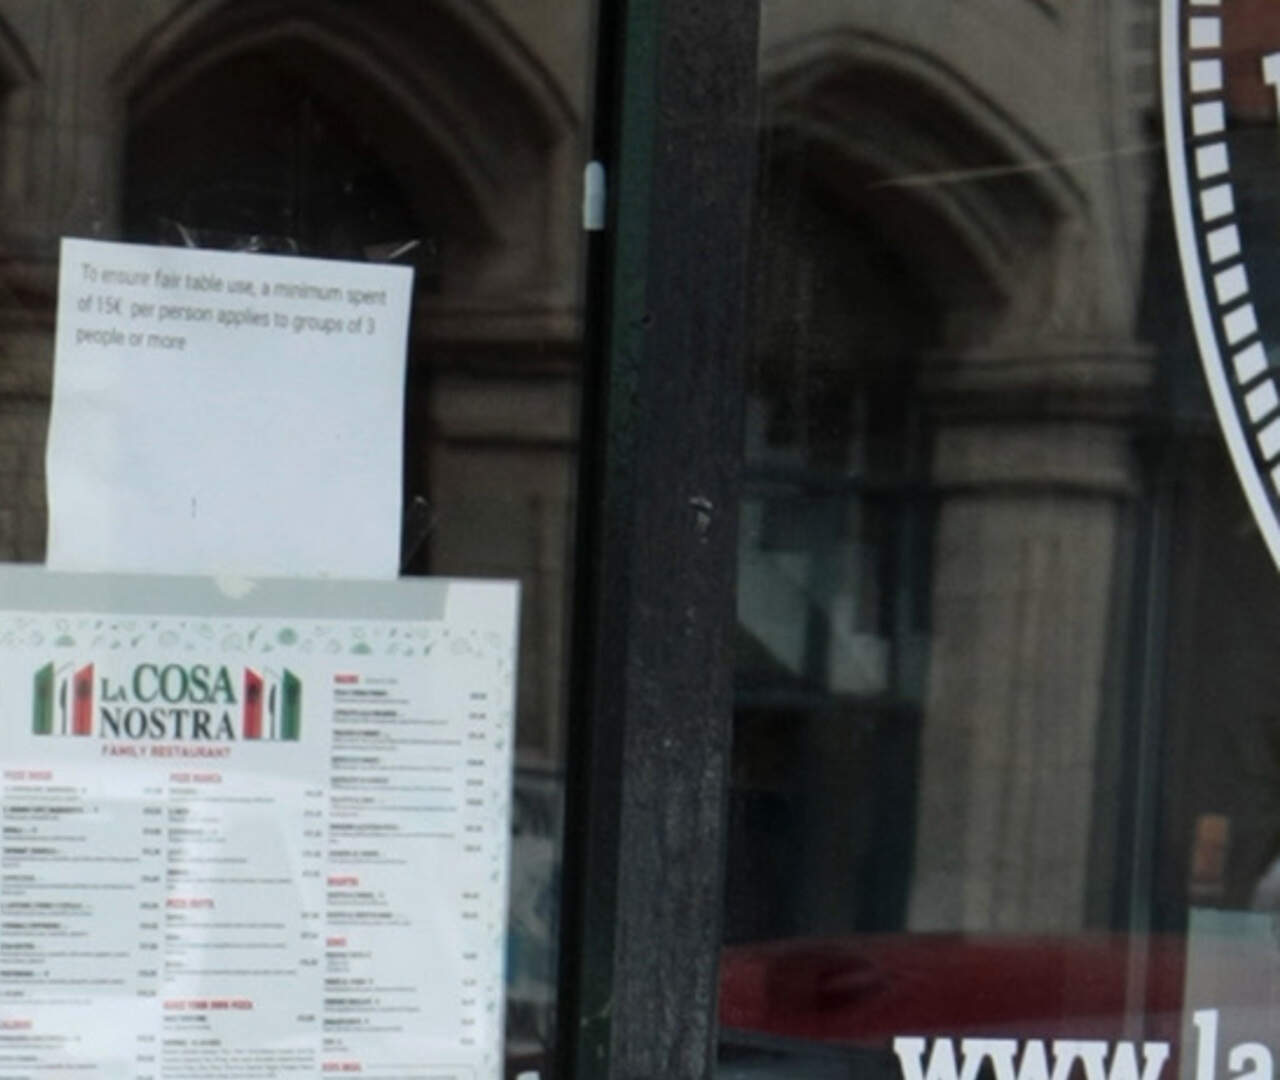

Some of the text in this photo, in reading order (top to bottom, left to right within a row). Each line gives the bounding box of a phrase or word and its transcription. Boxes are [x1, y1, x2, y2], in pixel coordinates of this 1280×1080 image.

[81, 263, 388, 308] To ensure fair table use, a minimum spent
[77, 295, 93, 312] of
[130, 303, 155, 322] per
[159, 304, 213, 325] person
[217, 308, 271, 329] applies
[273, 312, 289, 329] to
[292, 315, 344, 336] groups
[346, 314, 363, 334] of
[366, 317, 375, 335] 3
[76, 326, 187, 352] people or more
[132, 663, 237, 704] COSA
[100, 706, 236, 741] NOSTRA
[101, 744, 148, 757] FAMILY
